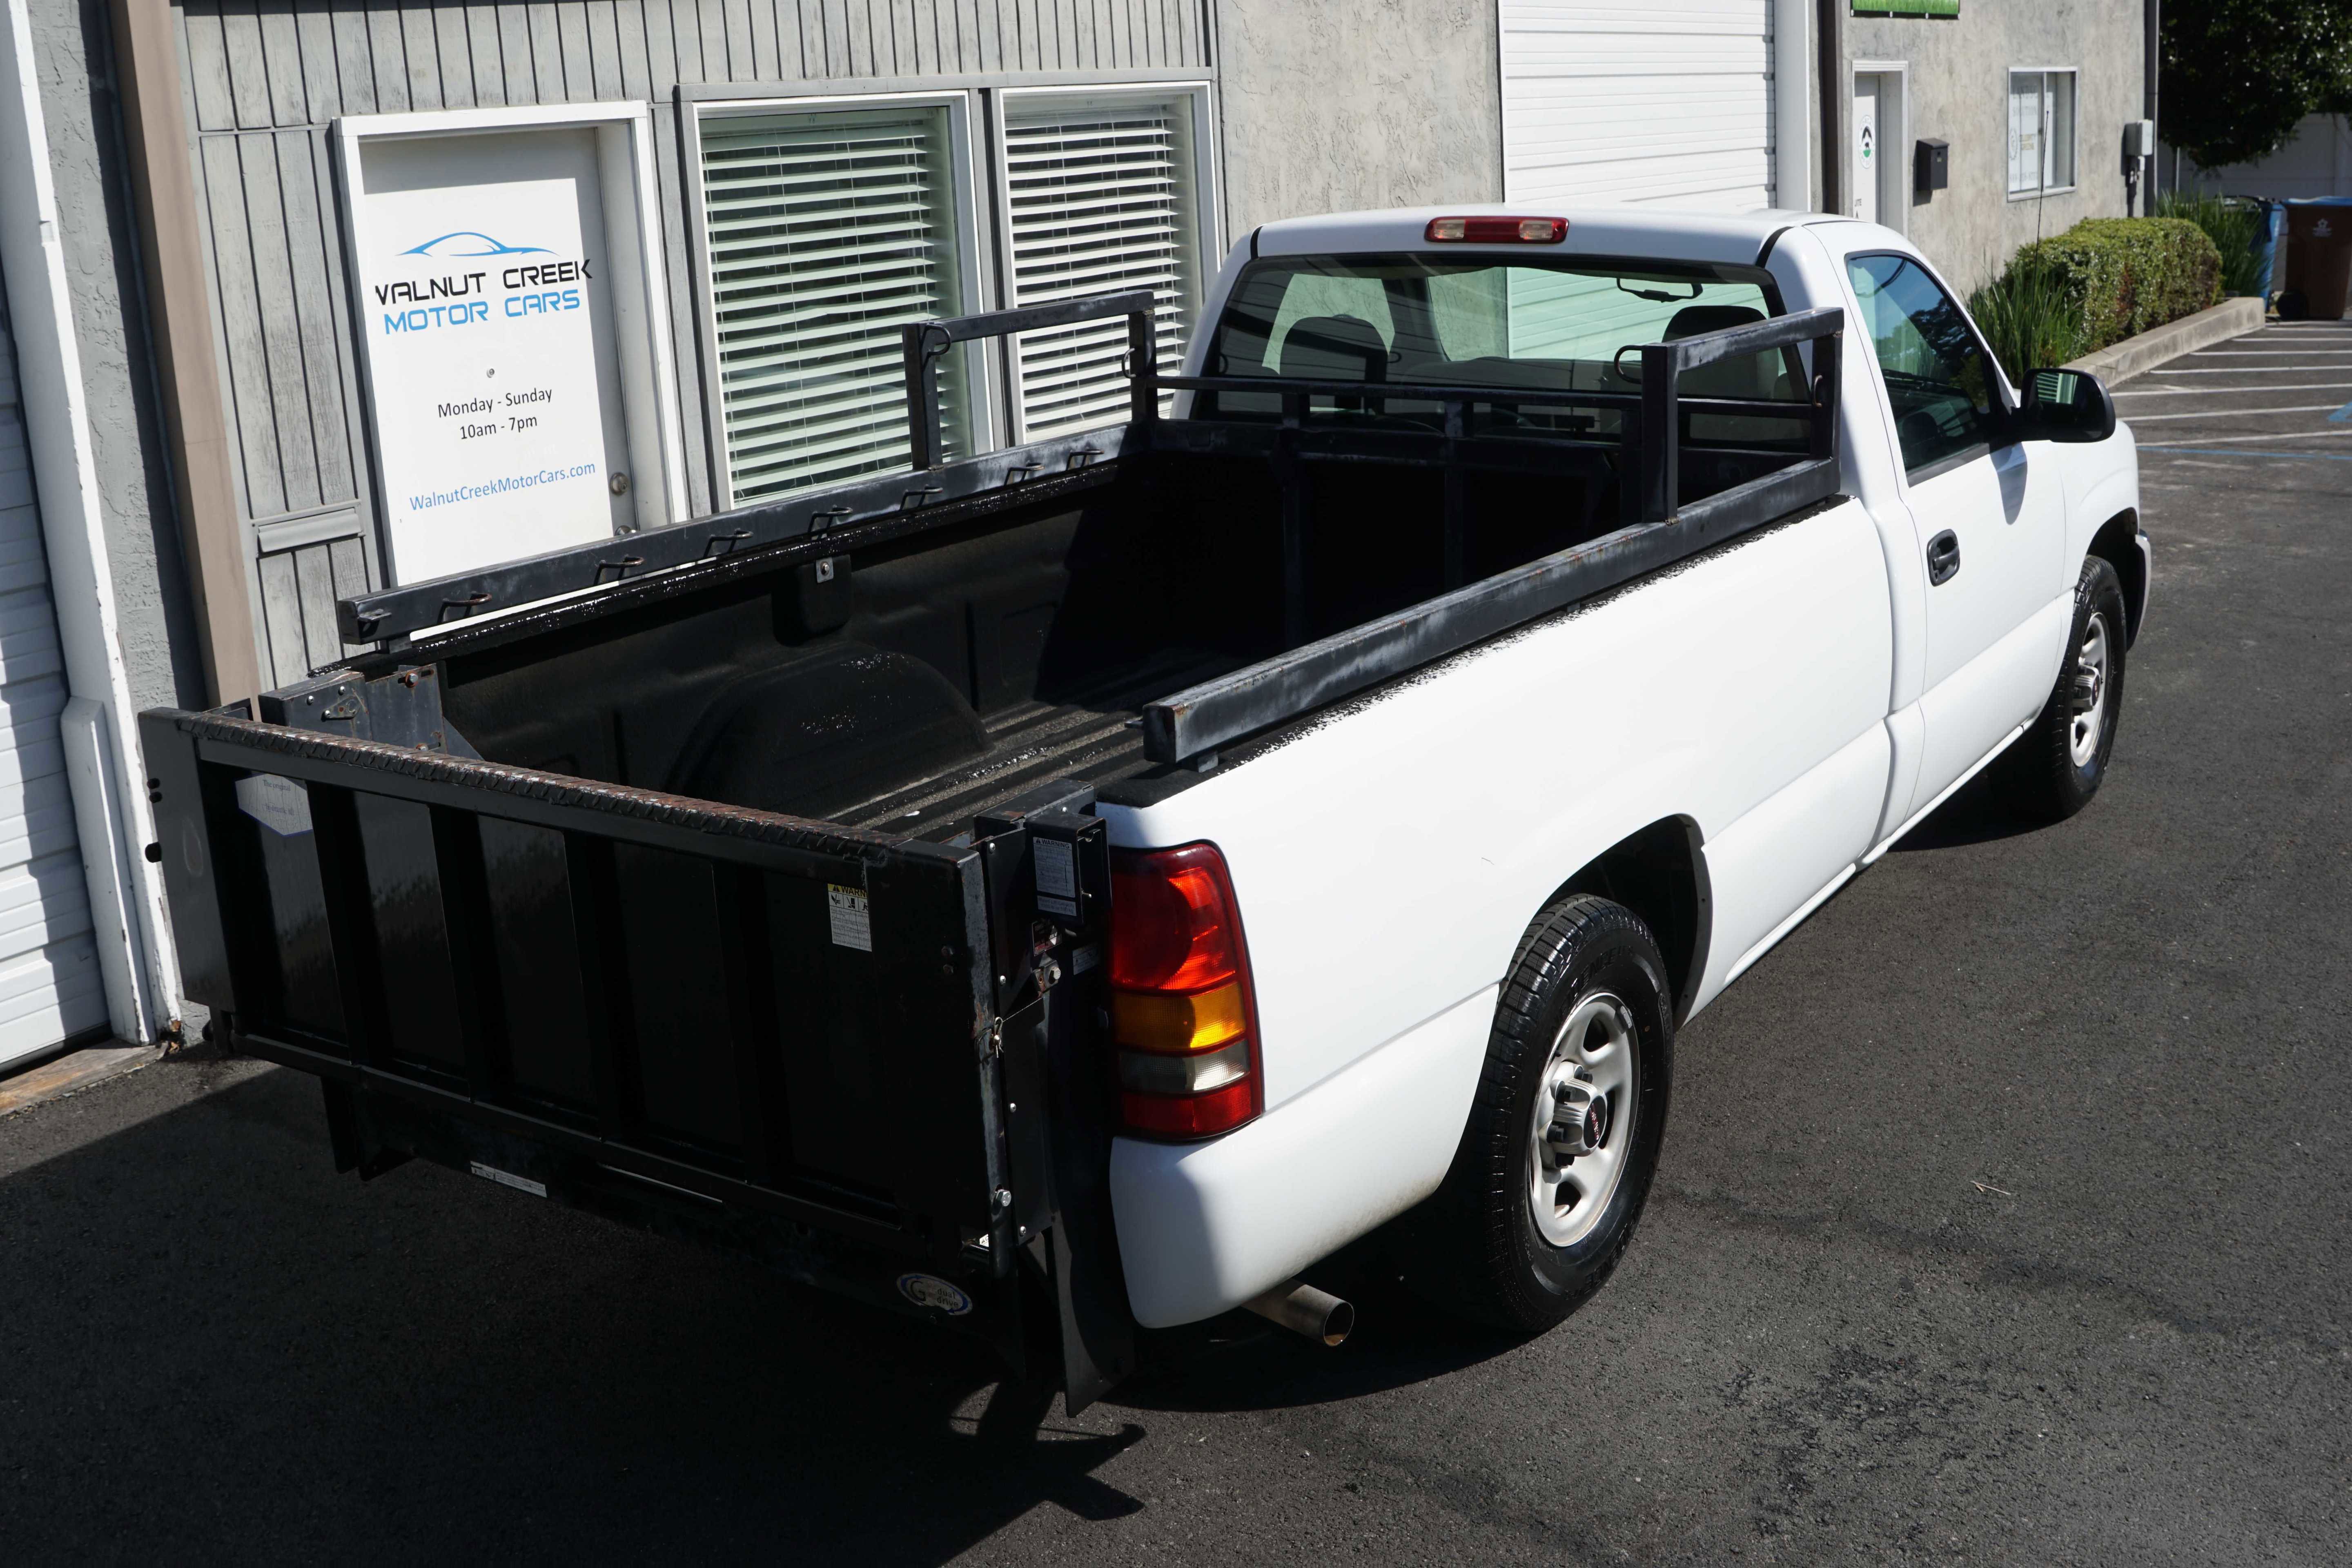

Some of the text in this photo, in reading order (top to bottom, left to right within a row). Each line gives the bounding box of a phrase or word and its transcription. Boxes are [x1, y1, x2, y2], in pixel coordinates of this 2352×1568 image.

[503, 259, 593, 289] CREEK
[384, 289, 580, 334] MOTOR CARS
[438, 398, 493, 418] Monday
[506, 388, 552, 406] Sunday
[460, 423, 497, 440] 10am
[508, 416, 537, 433] 7pm
[410, 463, 595, 510] WalnutCreekMotorCars.com
[1042, 838, 1069, 849] WARNING
[842, 885, 867, 898] WARN
[937, 1288, 956, 1298] dual
[937, 1297, 958, 1308] drive
